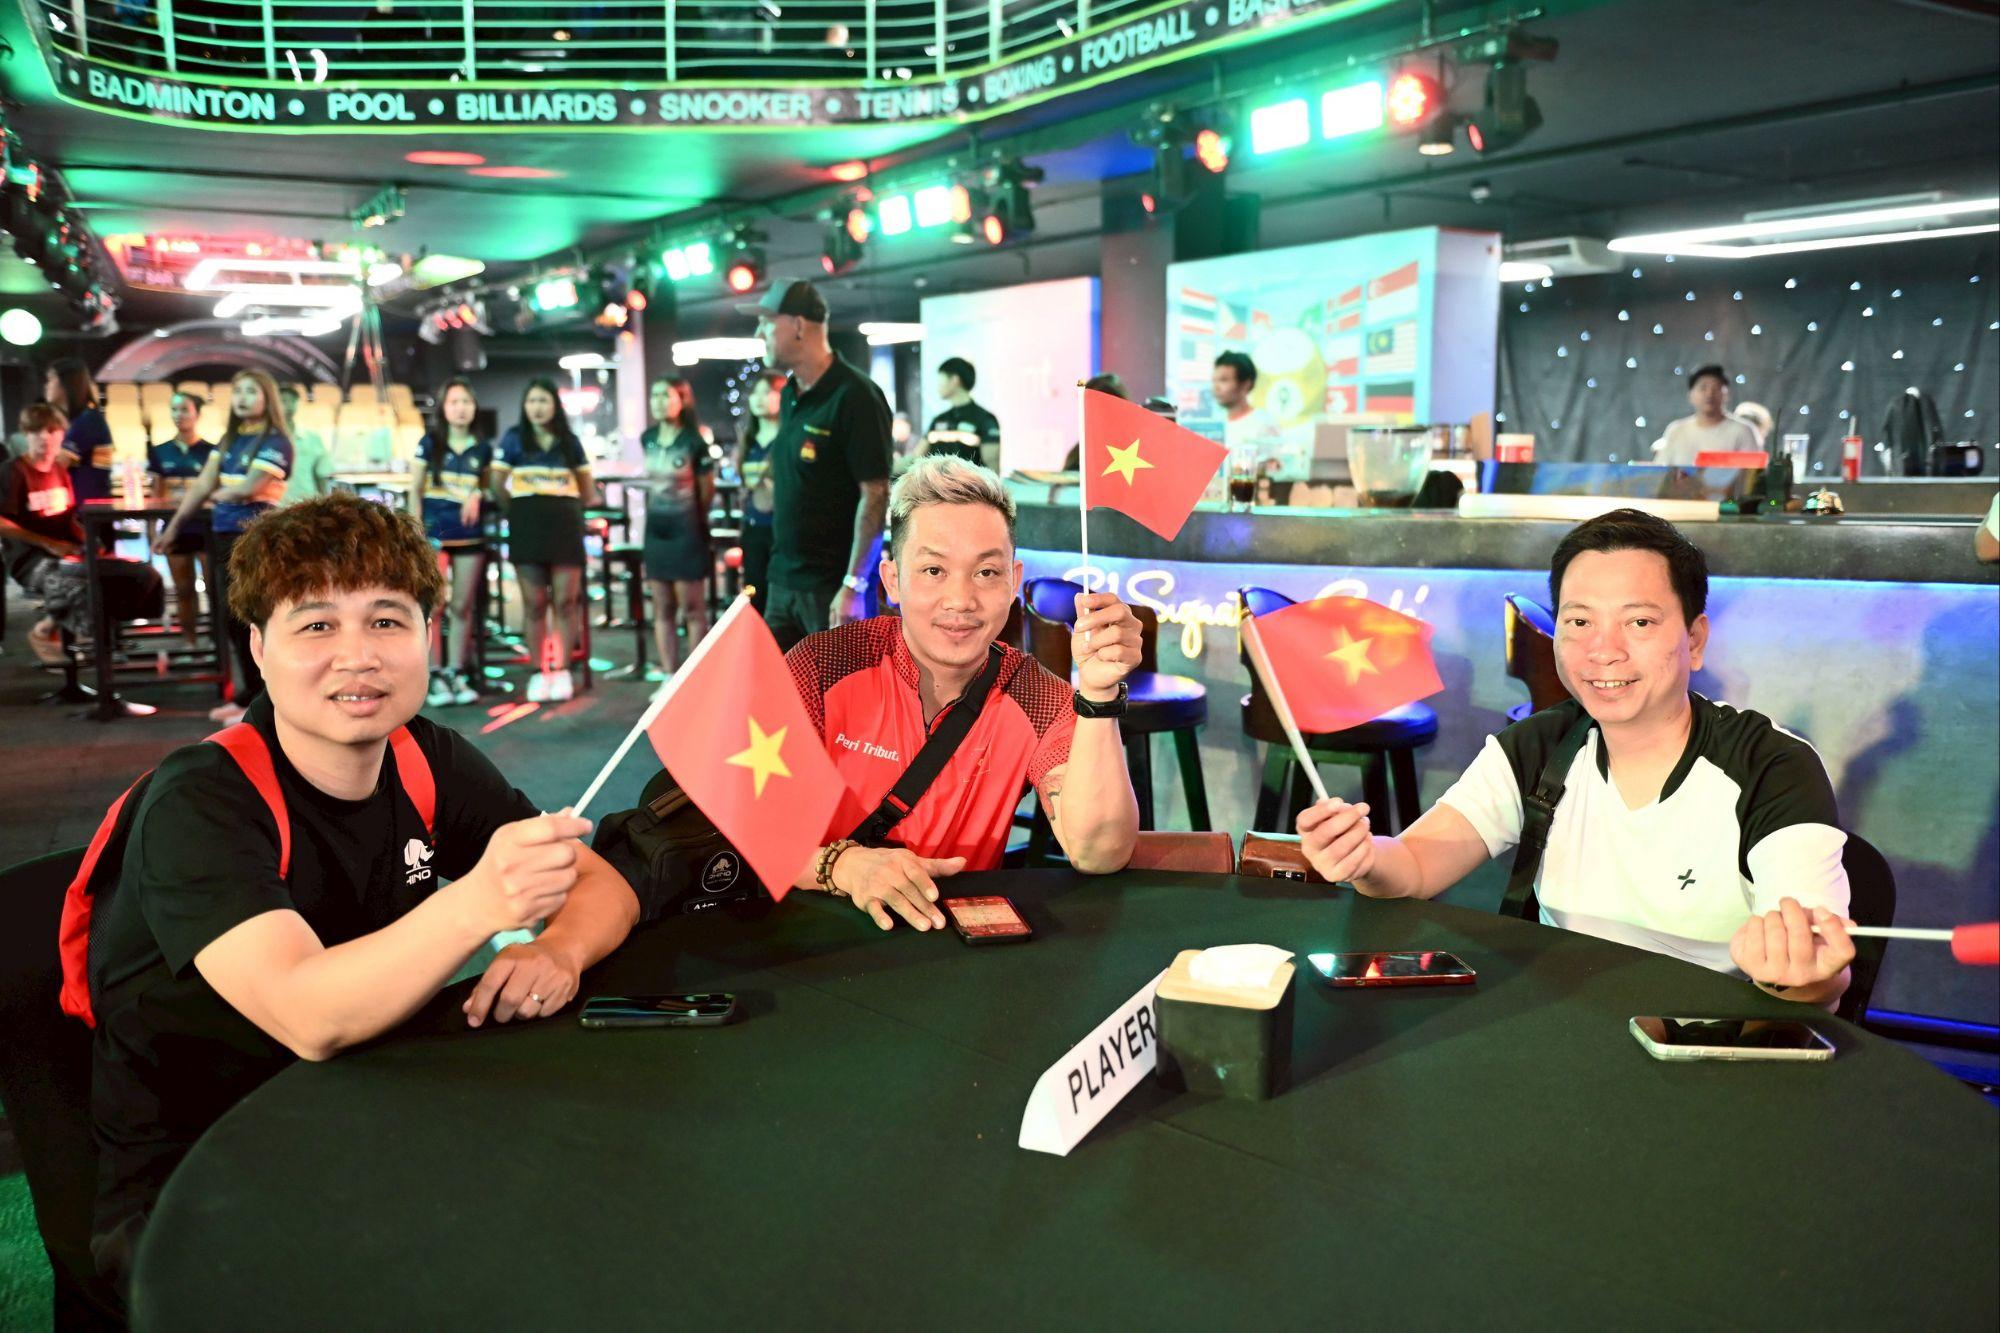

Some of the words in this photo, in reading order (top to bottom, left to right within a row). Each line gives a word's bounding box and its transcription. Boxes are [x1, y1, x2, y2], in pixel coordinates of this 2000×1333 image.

[89, 69, 275, 120] BADMINTON
[328, 93, 415, 121] POOL
[456, 93, 617, 121] BILLIARDS
[658, 93, 812, 120] SNOOKER
[855, 86, 959, 118] TENNIS
[984, 55, 1057, 104] BOXING
[1080, 9, 1196, 73] FOOTBALL
[834, 732, 860, 751] Peri
[862, 741, 900, 763] Tribut
